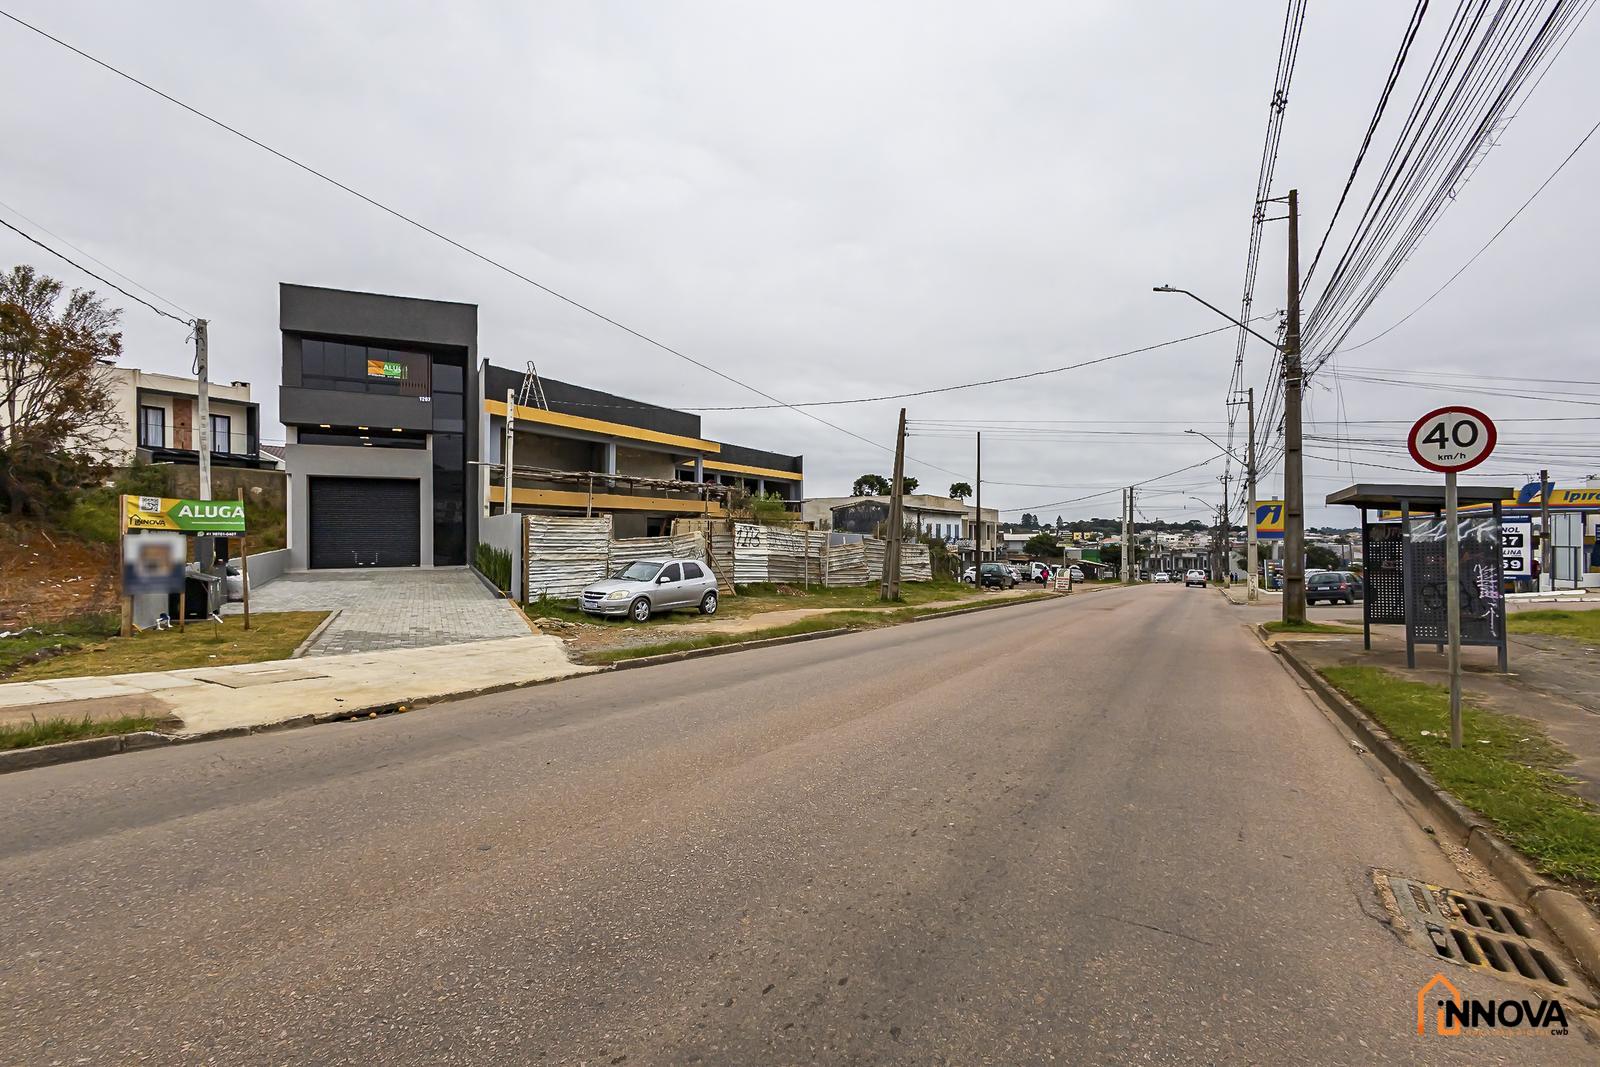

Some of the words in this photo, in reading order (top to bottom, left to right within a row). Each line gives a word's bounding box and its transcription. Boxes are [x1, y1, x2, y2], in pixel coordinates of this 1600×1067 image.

[1422, 420, 1478, 449] 40
[1438, 453, 1466, 461] km/h
[178, 505, 244, 518] ALUGA
